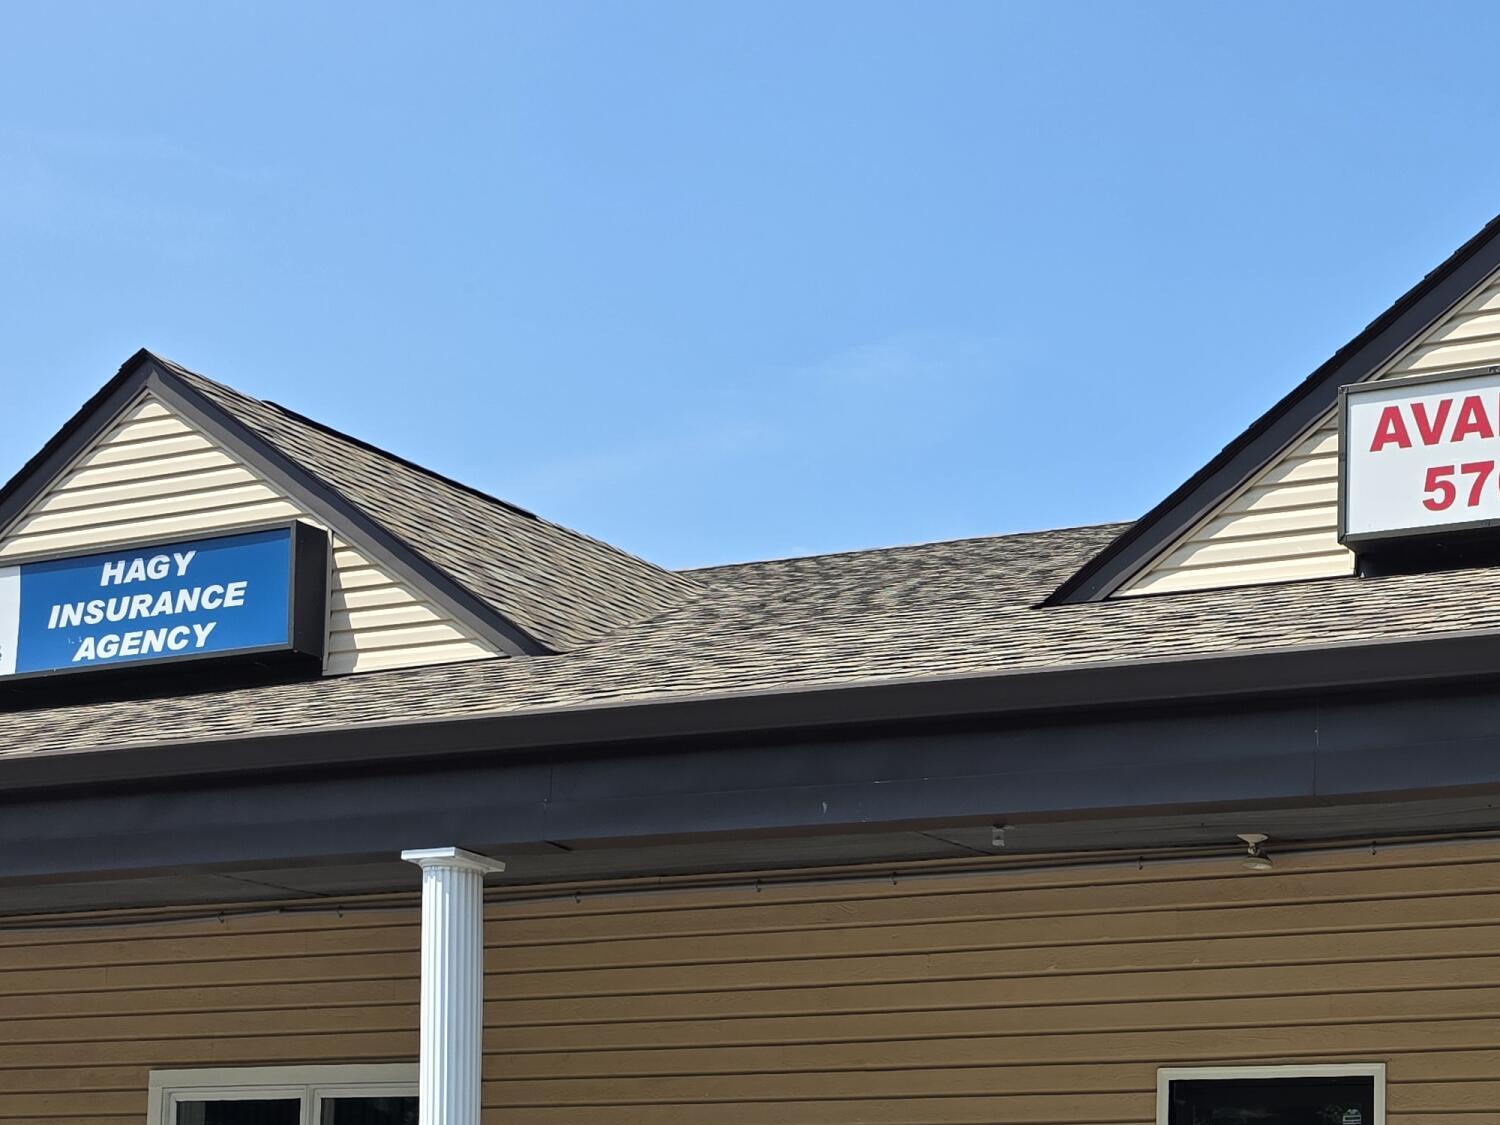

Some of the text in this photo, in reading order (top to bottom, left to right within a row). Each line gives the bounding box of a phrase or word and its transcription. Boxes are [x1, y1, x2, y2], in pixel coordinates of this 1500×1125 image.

[99, 550, 197, 587] HAGY
[47, 580, 248, 630] INSURANCE
[72, 622, 217, 662] AGENCY
